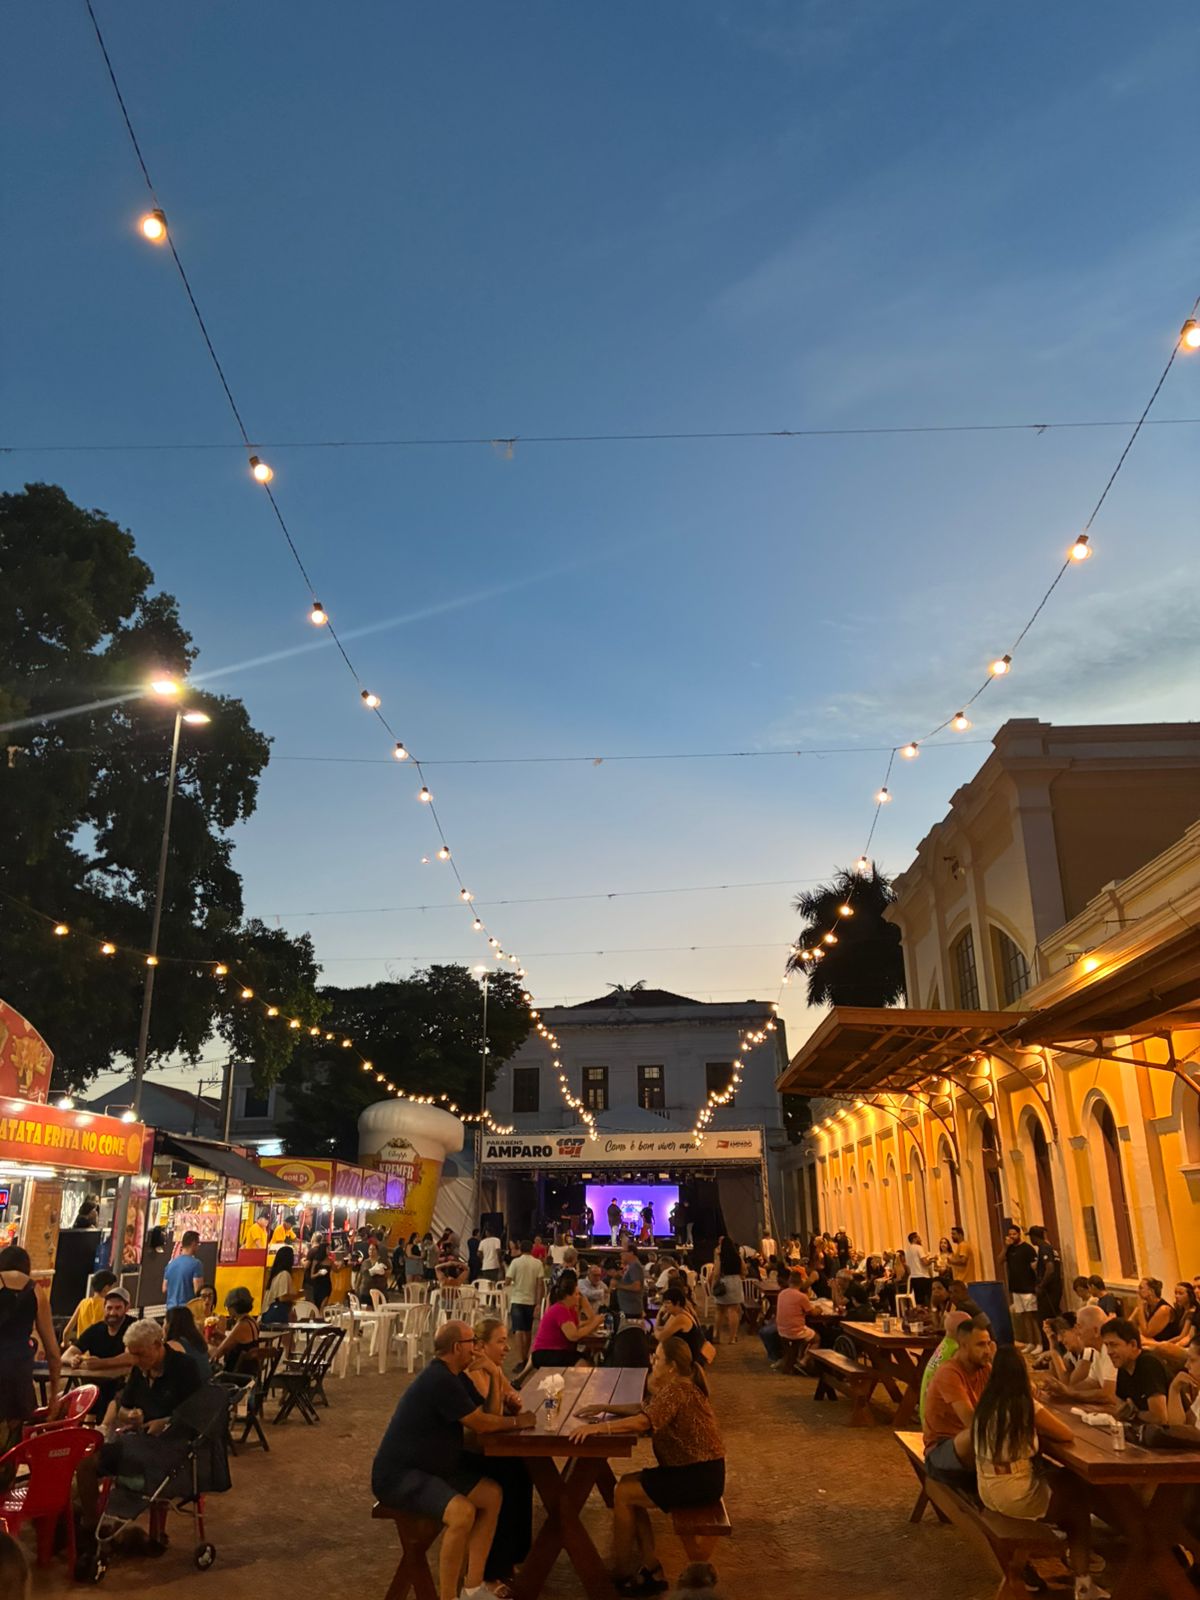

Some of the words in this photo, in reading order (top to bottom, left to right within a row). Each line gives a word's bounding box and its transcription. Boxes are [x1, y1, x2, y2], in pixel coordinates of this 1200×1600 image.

[44, 1124, 80, 1150] FRITA
[81, 1131, 97, 1153] NO
[98, 1134, 126, 1156] CONE
[604, 1139, 627, 1153] Como
[638, 1140, 655, 1151] bom
[657, 1142, 676, 1151] viver
[486, 1145, 553, 1158] AMPARO
